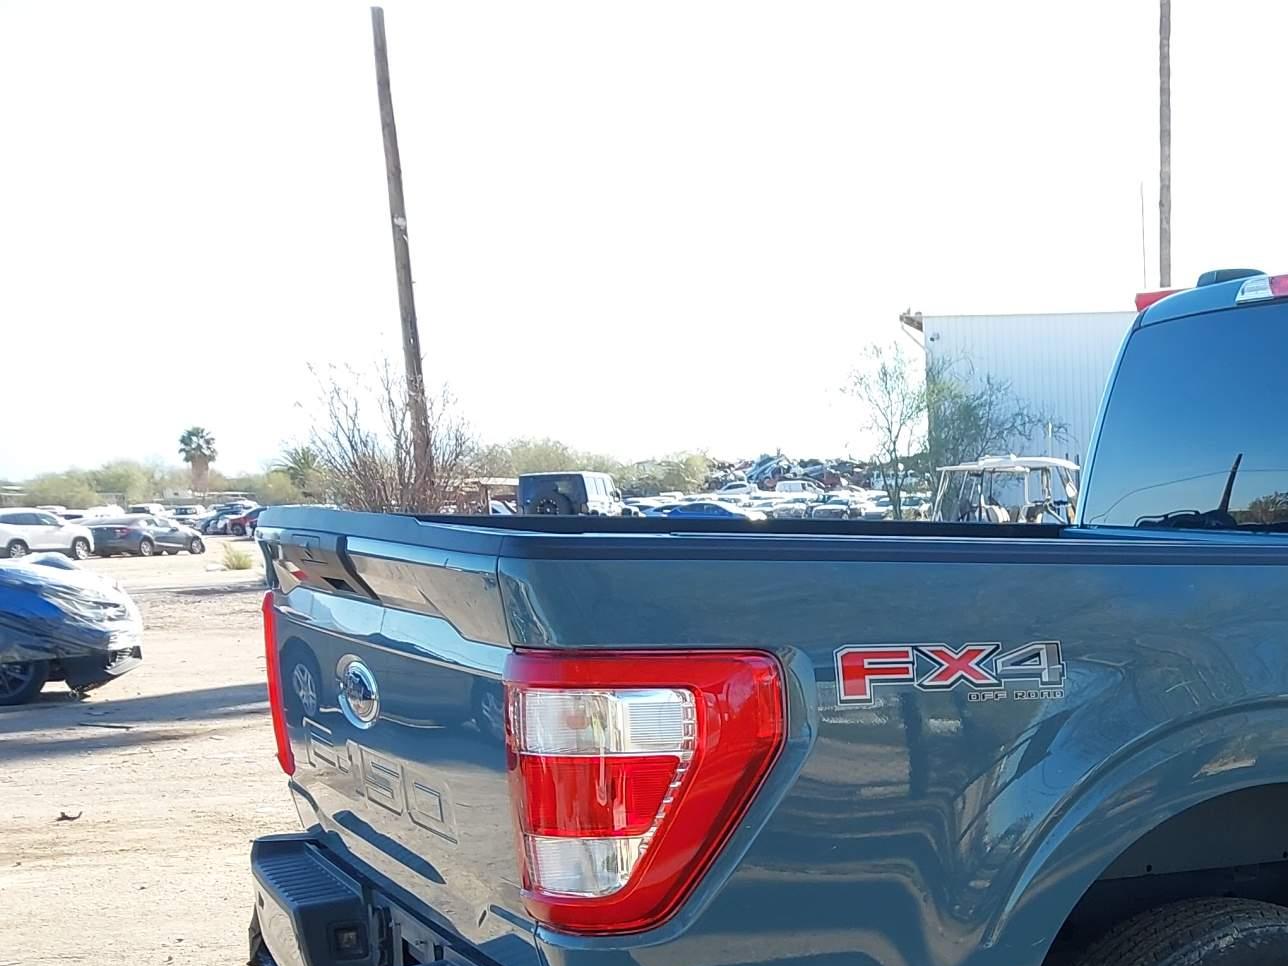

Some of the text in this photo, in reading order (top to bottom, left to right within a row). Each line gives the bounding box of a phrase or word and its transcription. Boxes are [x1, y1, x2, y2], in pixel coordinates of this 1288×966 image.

[833, 640, 1067, 706] FX4
[967, 689, 1065, 702] OFF ROAD
[302, 716, 458, 845] F-150
